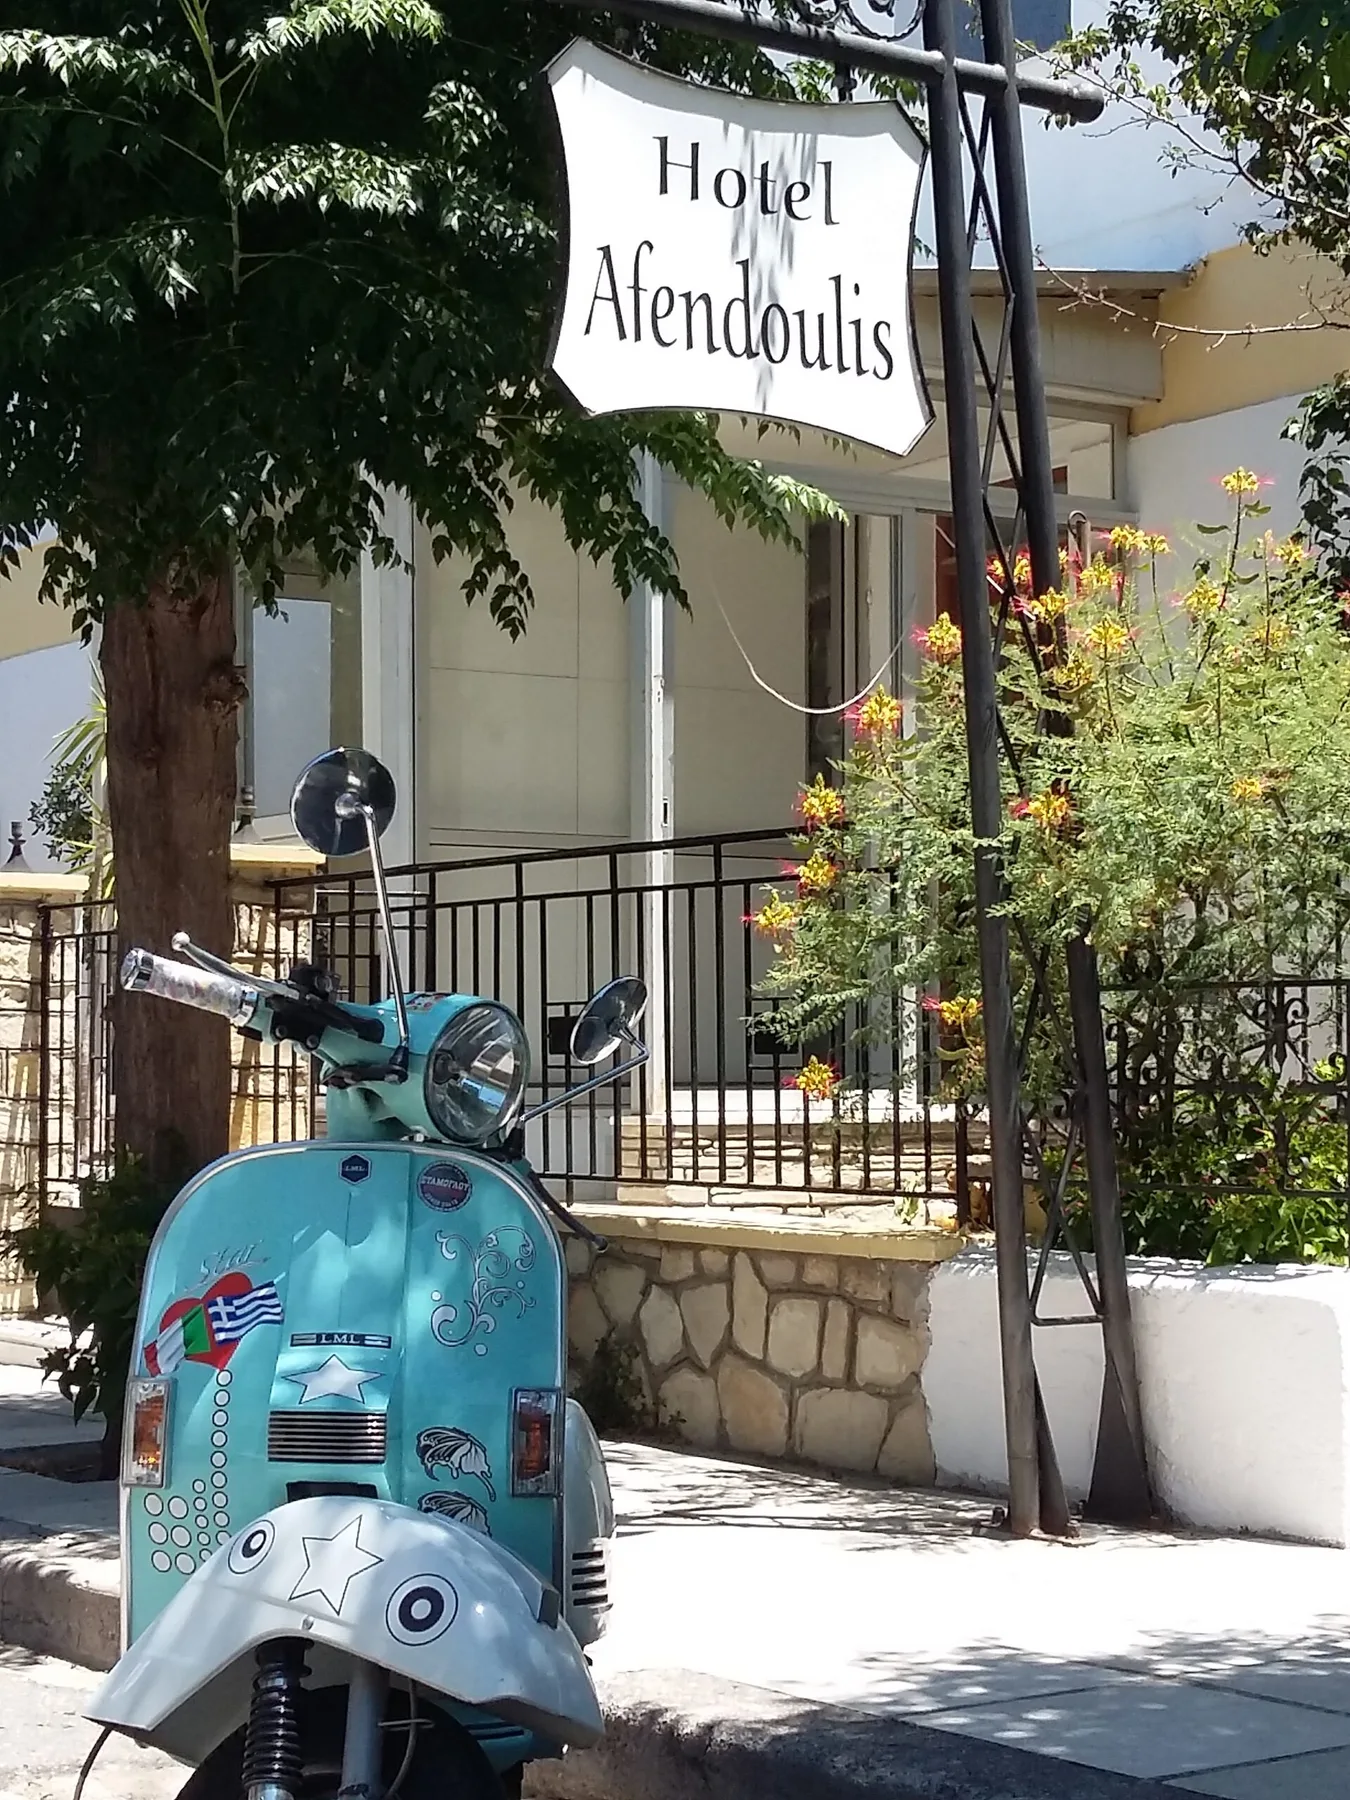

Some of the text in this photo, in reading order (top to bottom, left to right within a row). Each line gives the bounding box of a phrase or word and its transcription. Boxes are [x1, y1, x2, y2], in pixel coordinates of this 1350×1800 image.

[652, 136, 840, 226] Hotel
[584, 240, 894, 381] Afendoulis
[320, 1333, 360, 1345] LML
